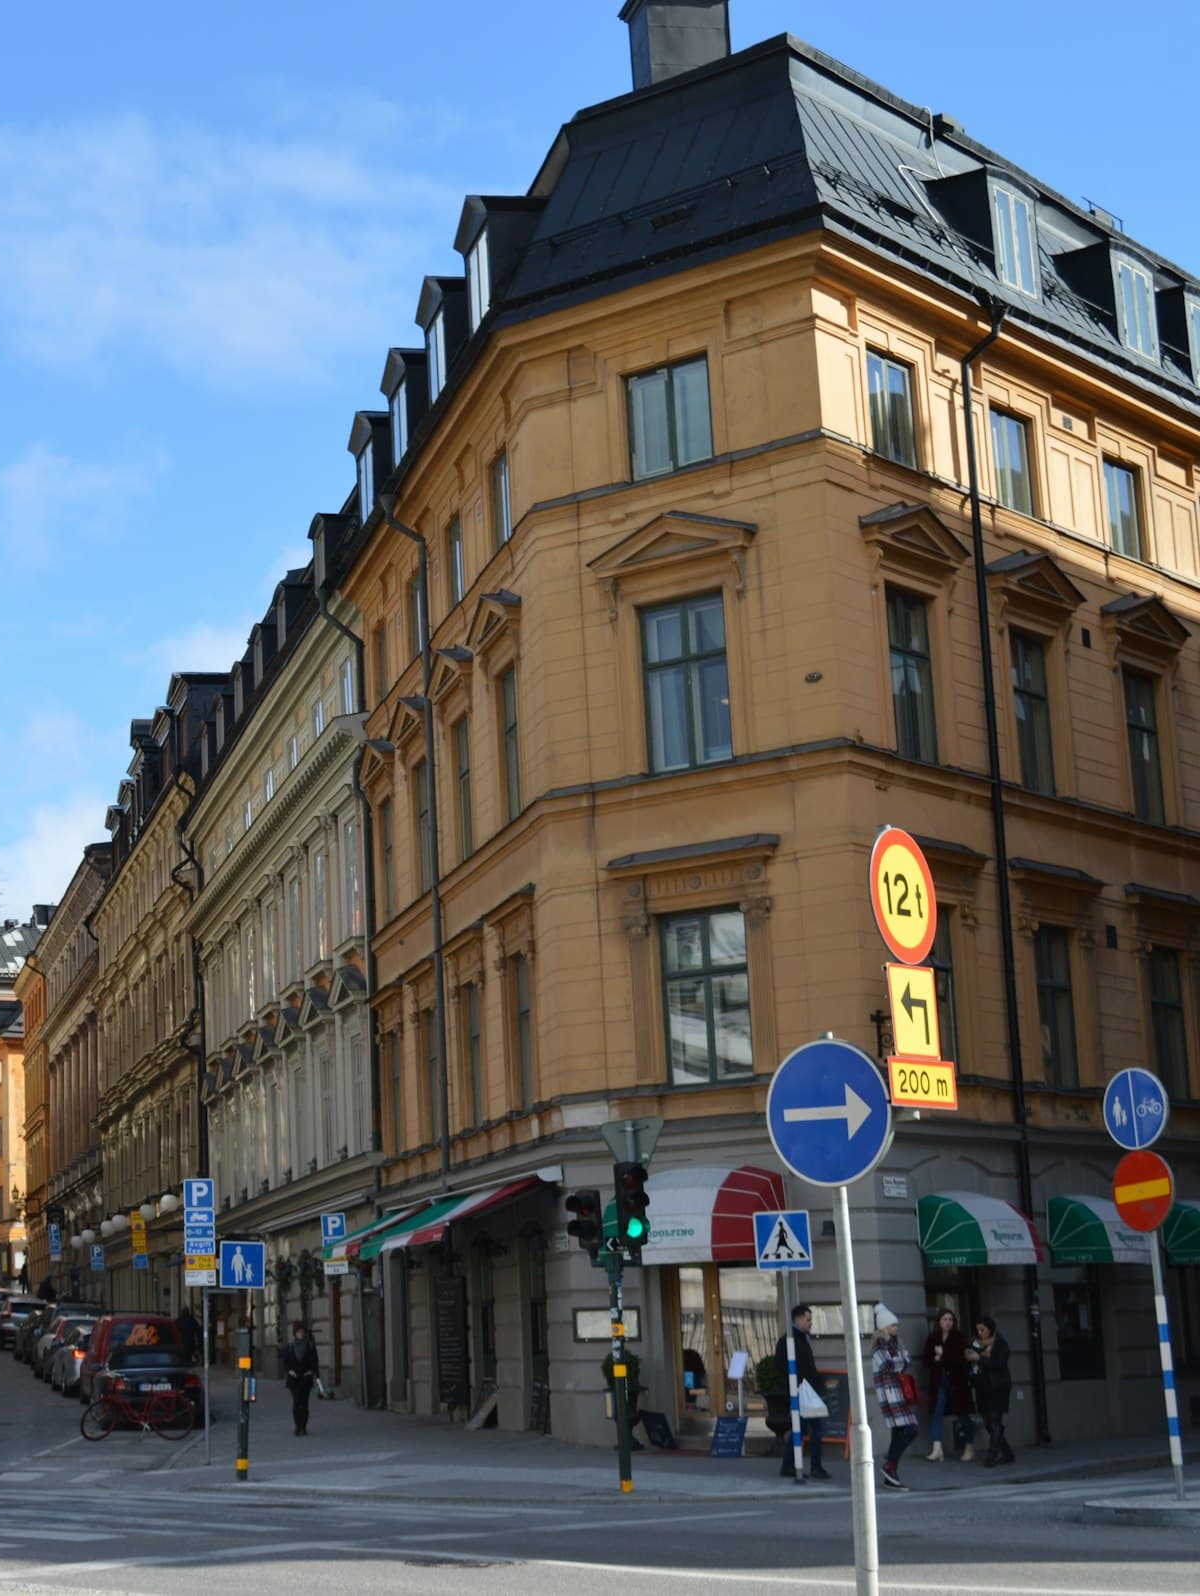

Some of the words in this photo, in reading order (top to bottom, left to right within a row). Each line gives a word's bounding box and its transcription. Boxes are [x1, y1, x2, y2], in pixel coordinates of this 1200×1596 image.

[883, 870, 912, 917] 12
[915, 883, 924, 918] t
[898, 1068, 931, 1095] 200
[936, 1077, 949, 1096] m
[192, 1182, 208, 1206] P
[328, 1216, 341, 1236] P
[93, 1247, 101, 1257] P
